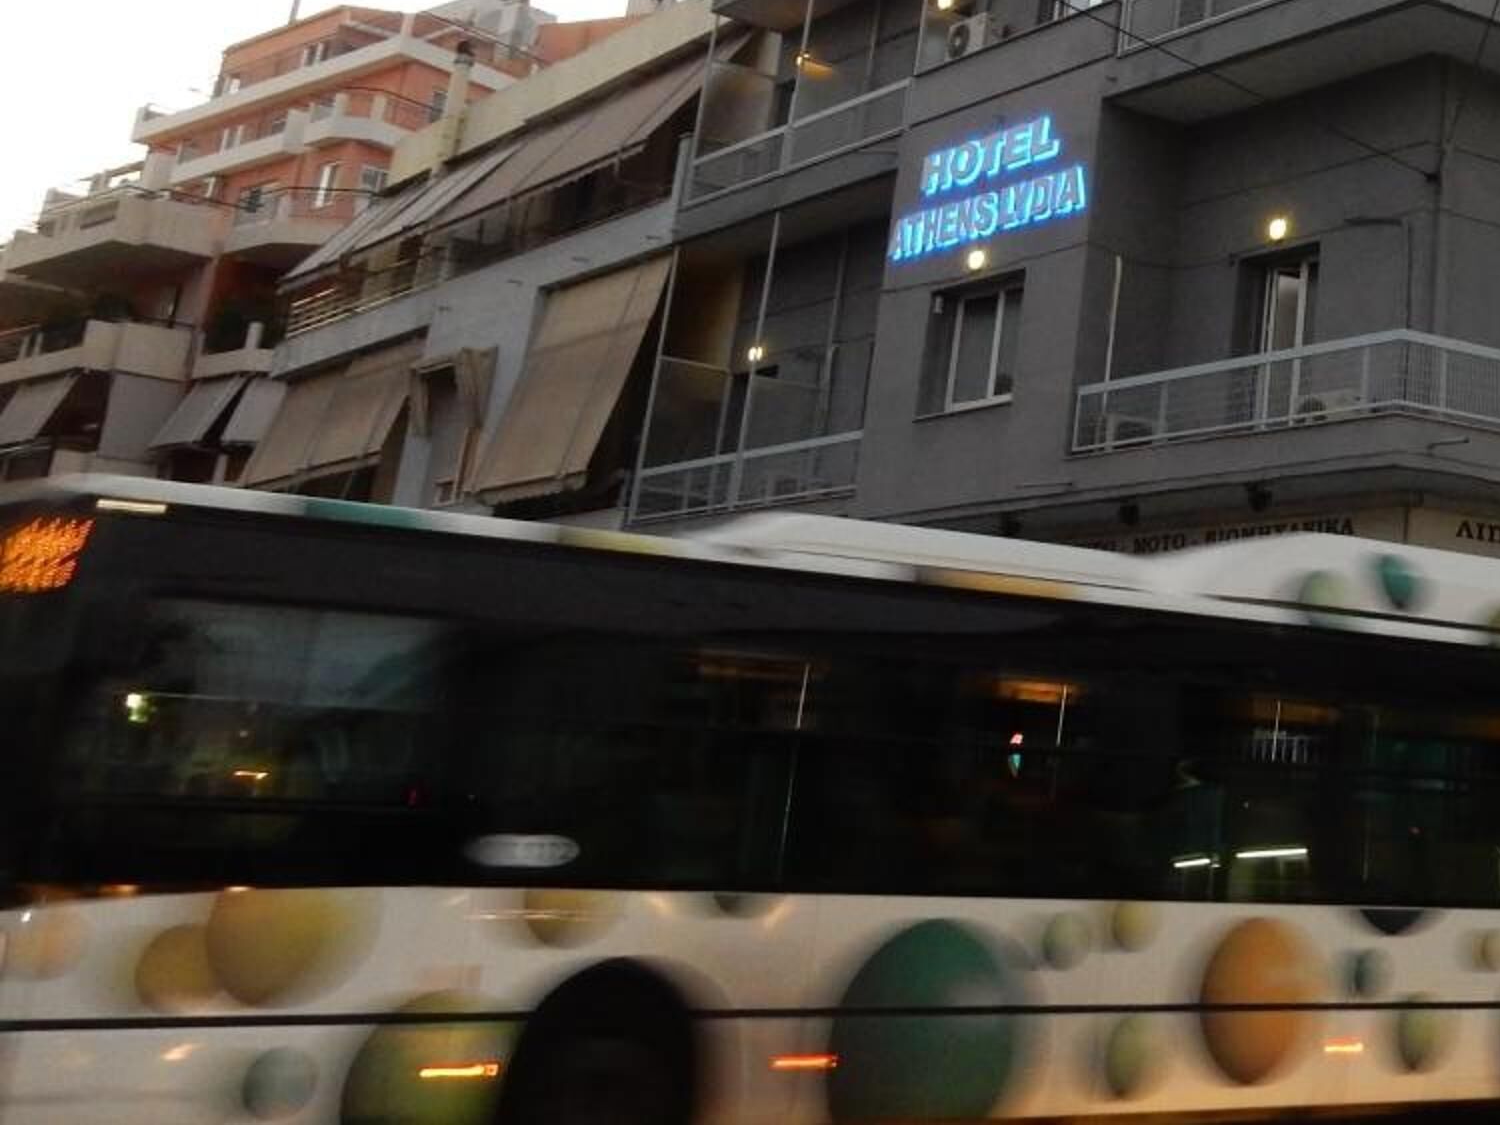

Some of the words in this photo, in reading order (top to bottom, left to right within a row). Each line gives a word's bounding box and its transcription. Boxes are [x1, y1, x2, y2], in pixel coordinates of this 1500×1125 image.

[920, 116, 1062, 197] HOTEL
[887, 191, 1000, 261] ATHENS
[1001, 164, 1086, 230] LYDIA
